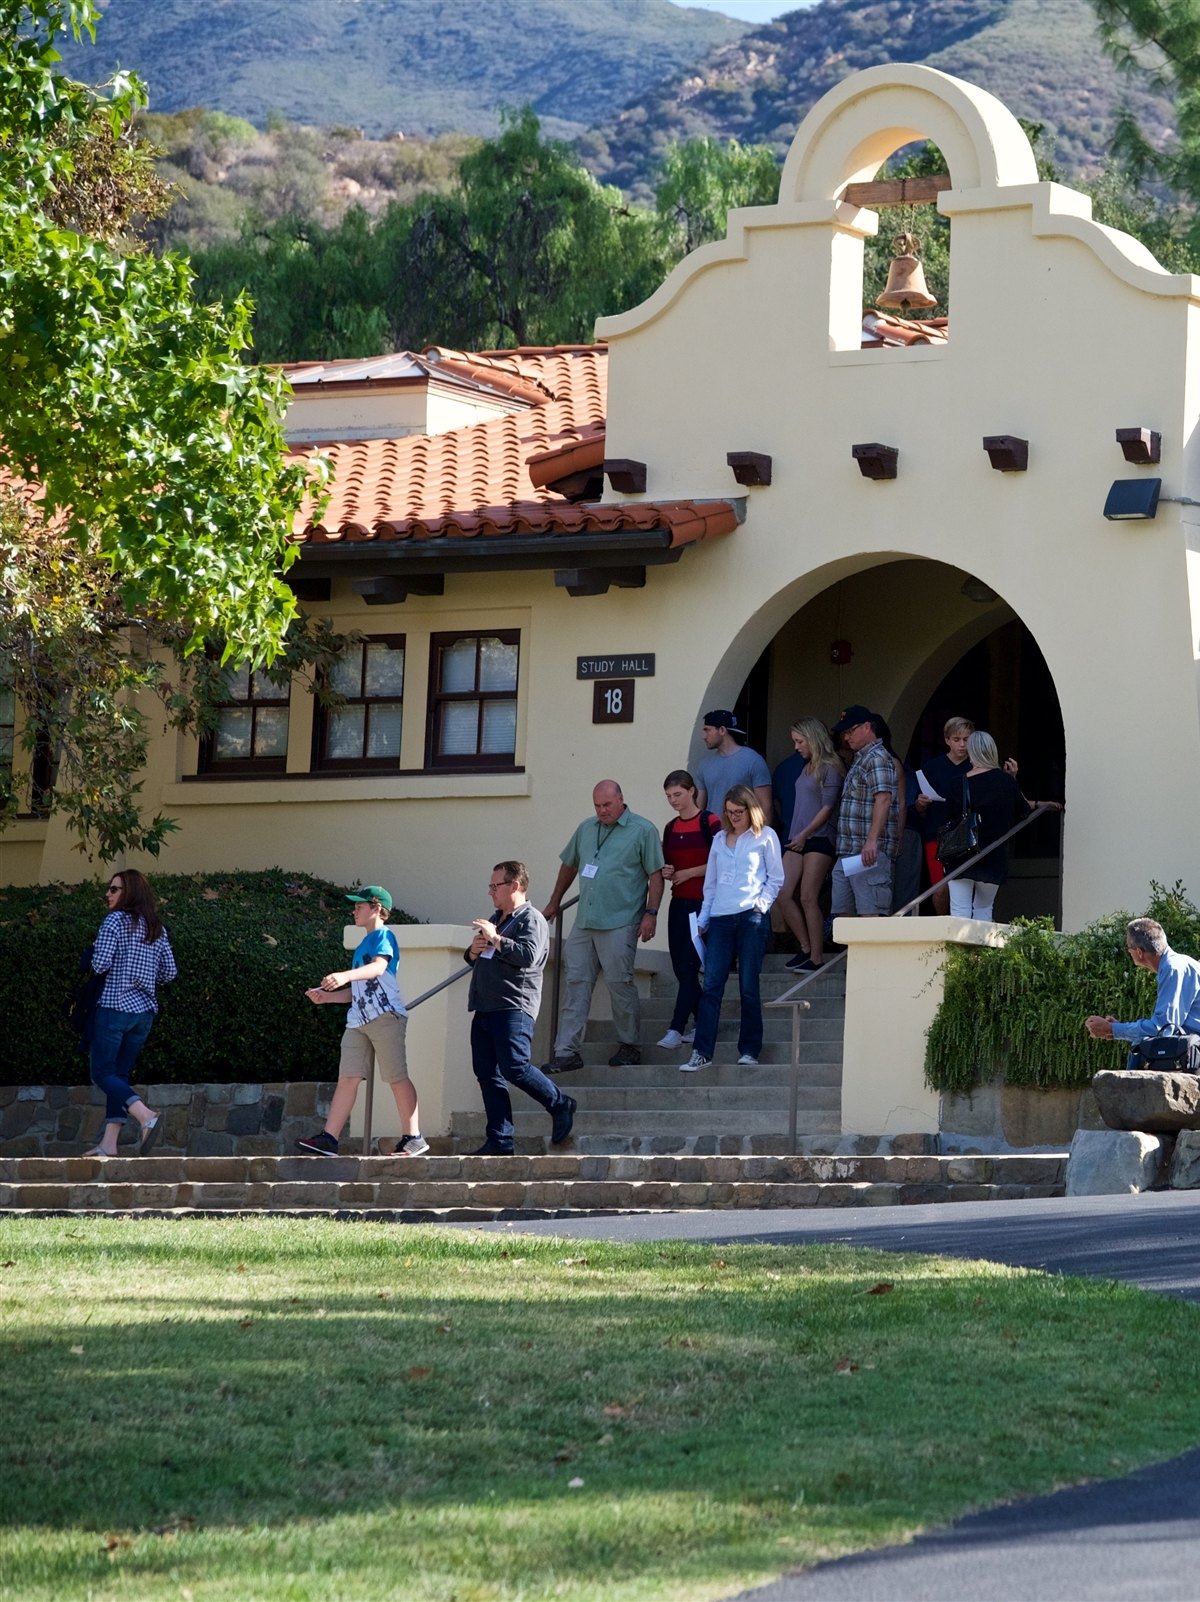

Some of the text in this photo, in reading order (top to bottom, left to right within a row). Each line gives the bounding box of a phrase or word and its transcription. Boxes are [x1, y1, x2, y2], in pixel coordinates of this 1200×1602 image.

[581, 659, 649, 673] STUDY HALL
[604, 688, 623, 714] 18
